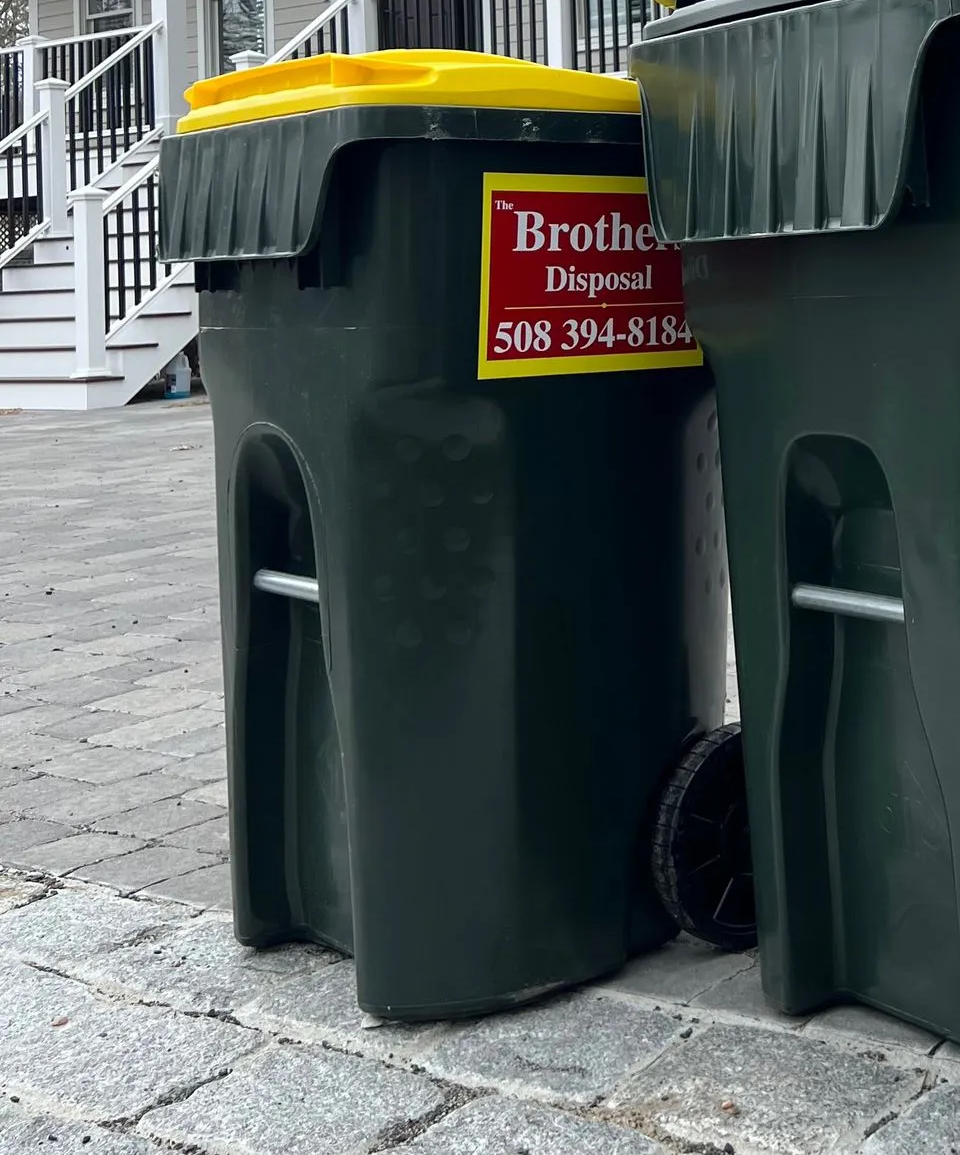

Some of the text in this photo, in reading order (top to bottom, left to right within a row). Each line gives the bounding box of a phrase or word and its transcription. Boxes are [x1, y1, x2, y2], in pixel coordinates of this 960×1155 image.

[495, 200, 514, 210] The
[512, 211, 681, 252] Brothe
[545, 265, 653, 298] Disposal
[493, 315, 693, 354] 508 394-8184
